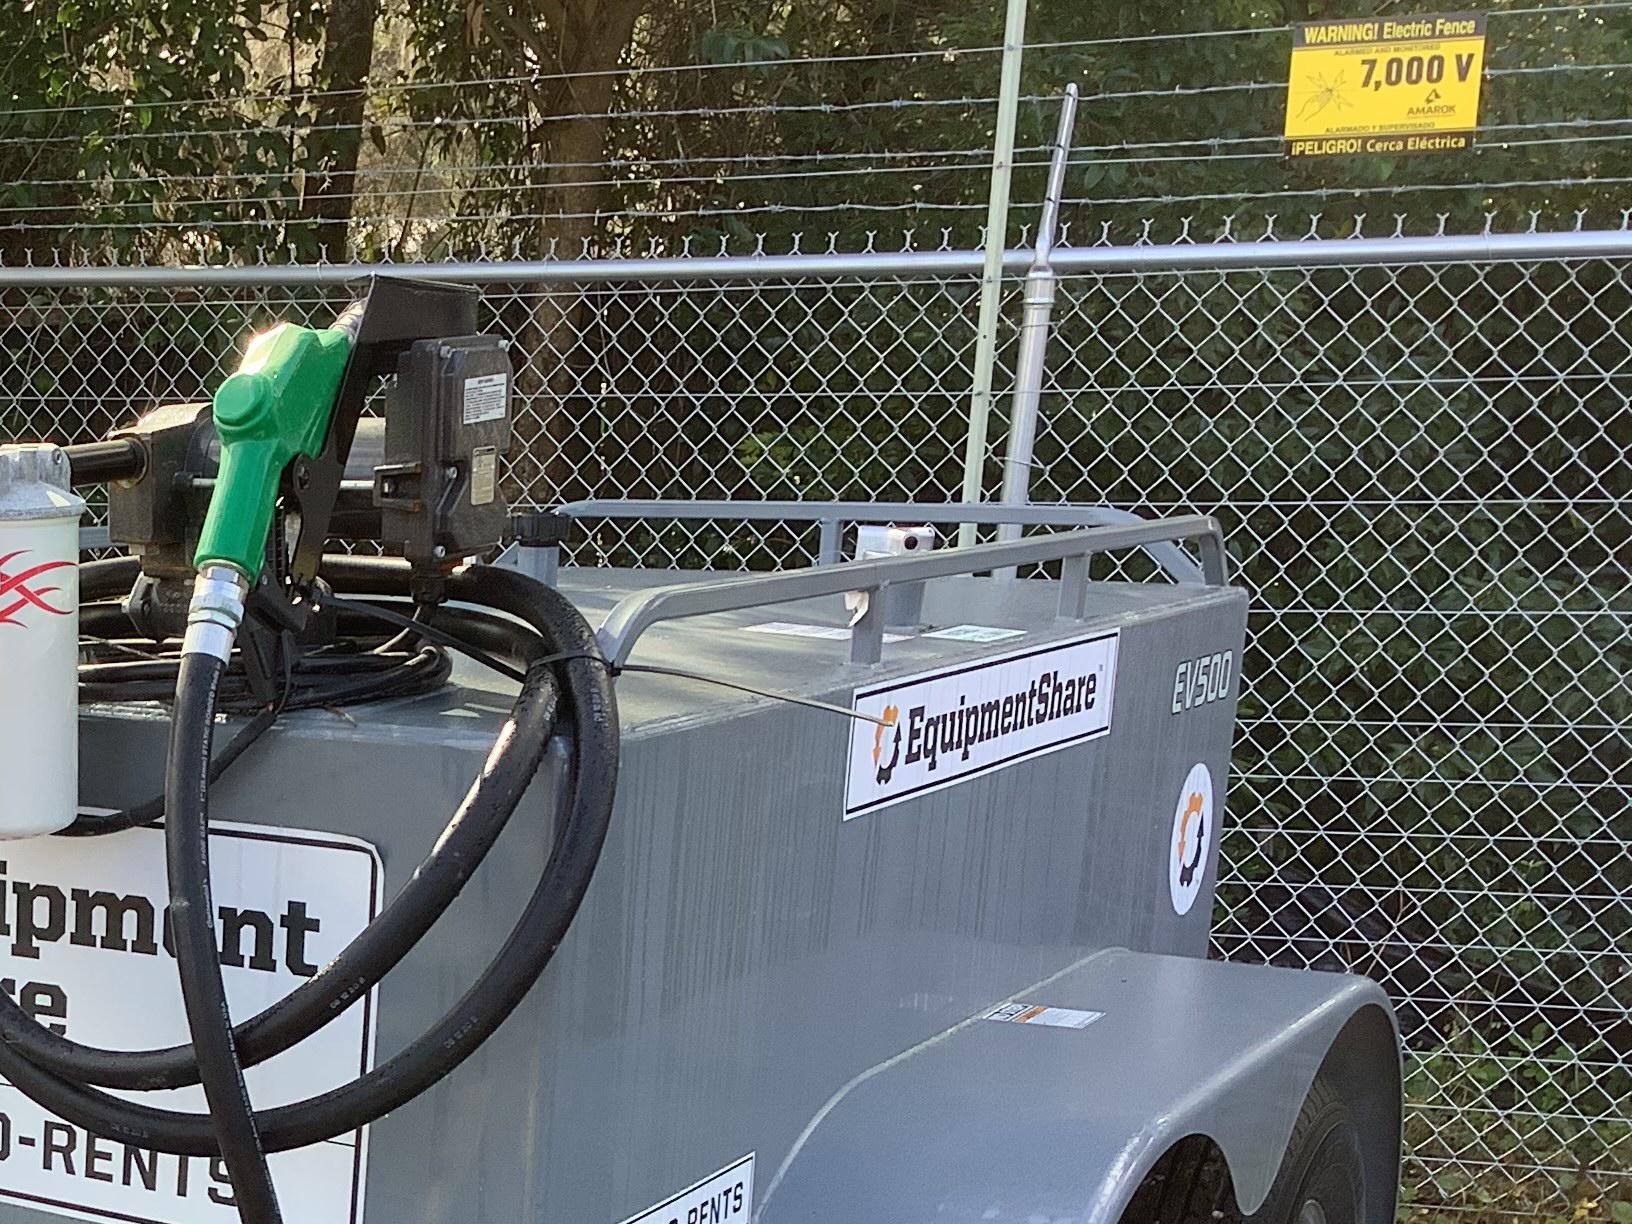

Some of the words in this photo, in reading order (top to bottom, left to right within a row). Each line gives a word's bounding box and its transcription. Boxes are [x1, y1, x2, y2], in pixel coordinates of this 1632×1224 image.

[1304, 22, 1378, 44] WARNING!
[1383, 19, 1432, 39] Electric
[1435, 18, 1476, 35] Fence
[1360, 54, 1445, 91] 7,000
[1456, 53, 1476, 82] V
[1406, 104, 1456, 116] AMAROK
[1291, 139, 1362, 156] ¡PELIGRO!
[1366, 139, 1404, 153] Cerca
[1407, 135, 1466, 150] Eléctrica
[1171, 649, 1233, 715] EV500
[904, 670, 1097, 771] EquipmentShare
